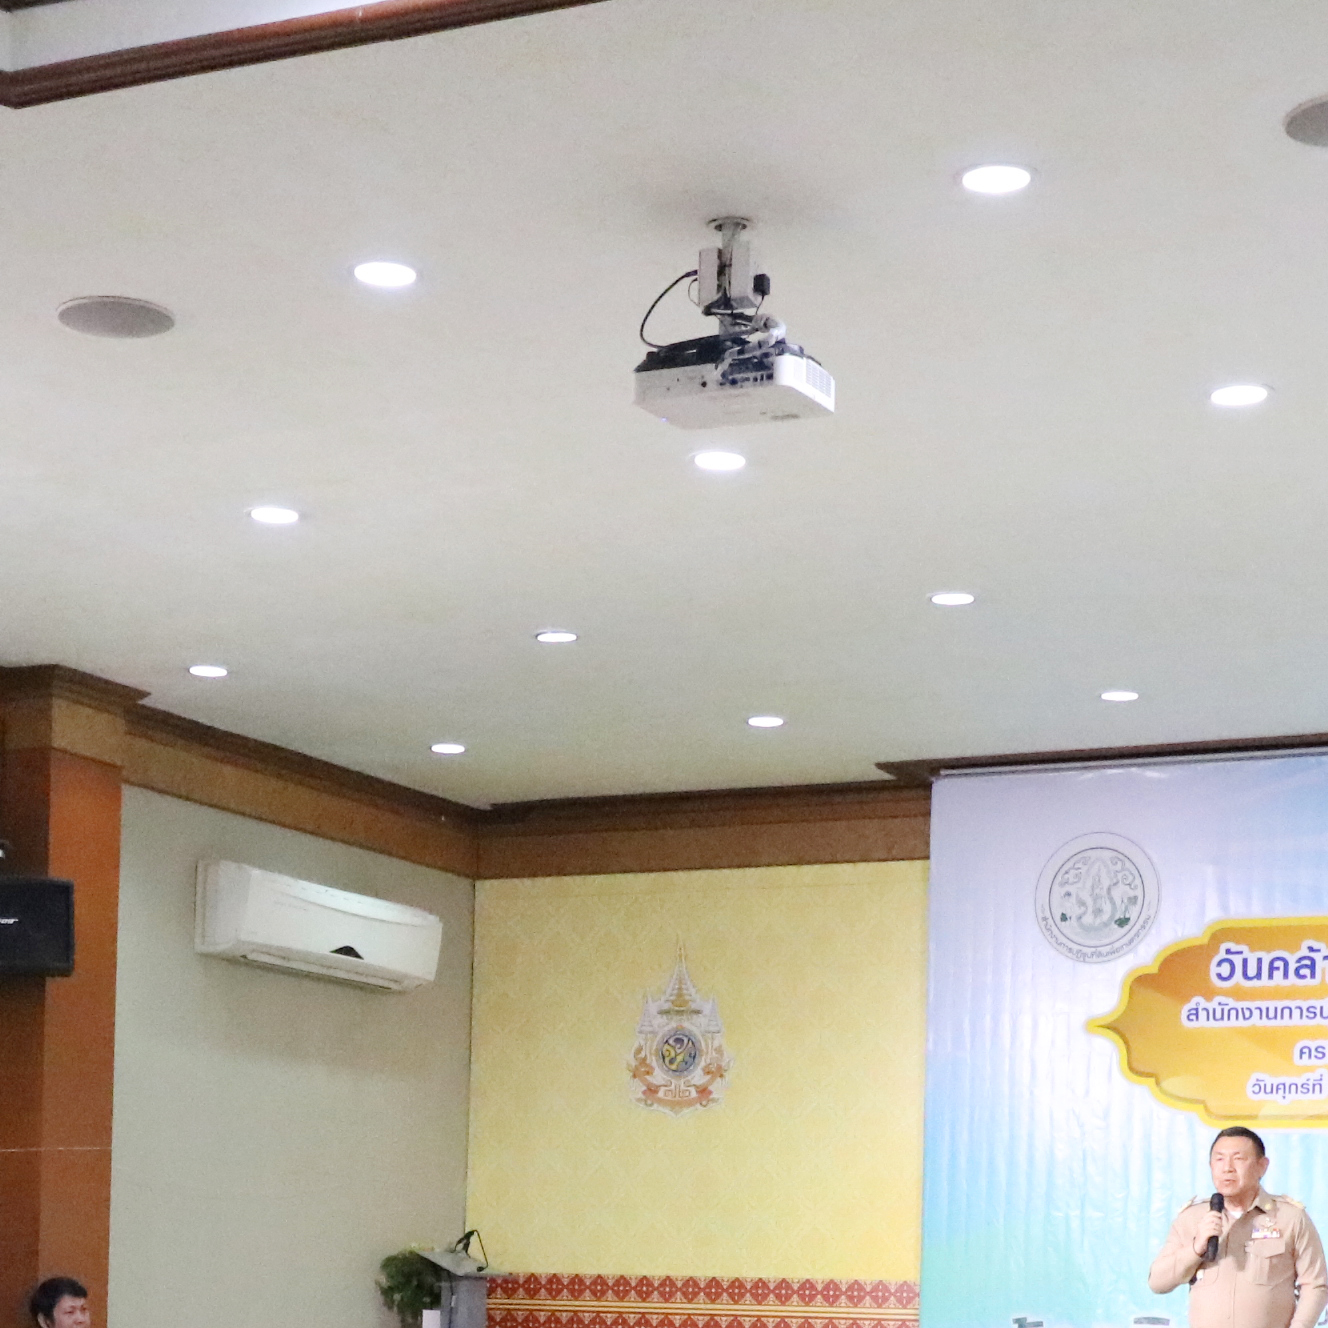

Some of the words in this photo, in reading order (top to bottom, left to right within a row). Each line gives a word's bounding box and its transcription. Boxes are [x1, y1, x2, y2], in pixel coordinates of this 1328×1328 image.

[1251, 1073, 1324, 1099] วันศุกร์ที่
